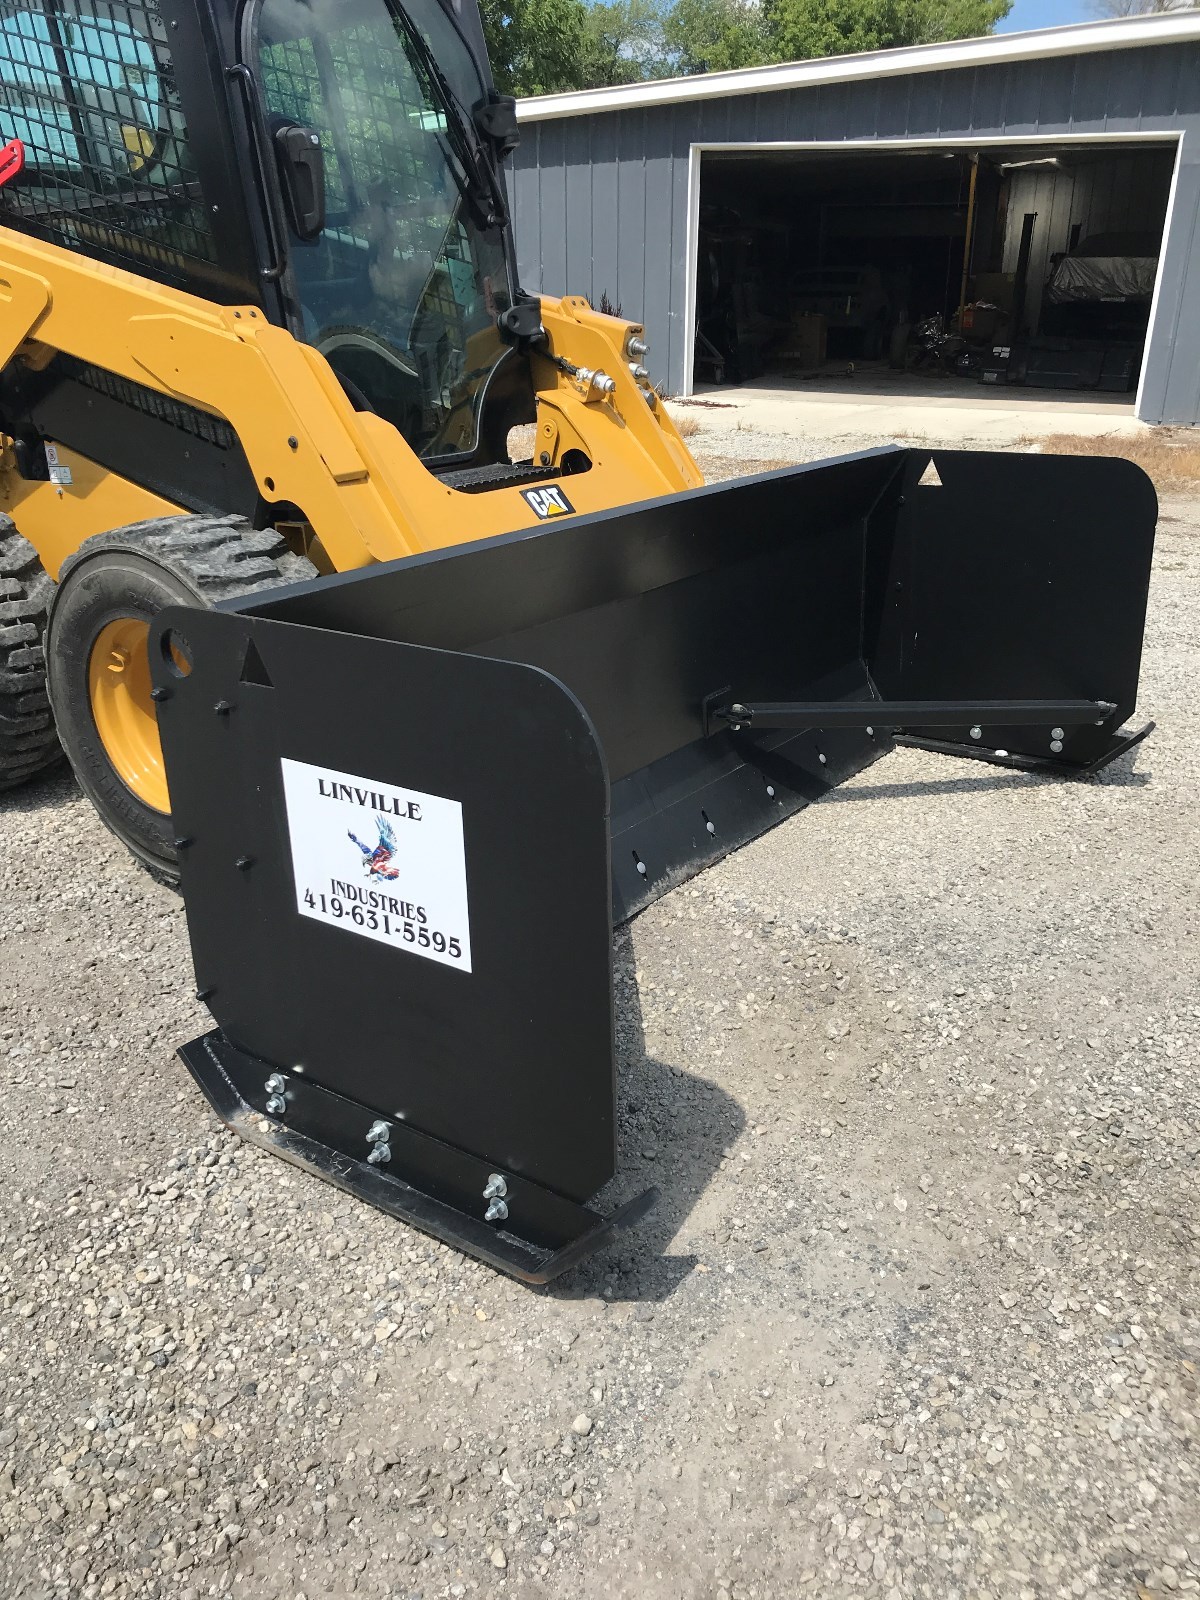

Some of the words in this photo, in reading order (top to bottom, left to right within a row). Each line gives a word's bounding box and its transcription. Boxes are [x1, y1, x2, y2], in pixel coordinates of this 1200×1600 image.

[526, 487, 569, 517] CAT
[318, 778, 423, 821] LINVILLE
[304, 887, 462, 958] 419-631-5595
[331, 878, 428, 924] INDUSTRIES
